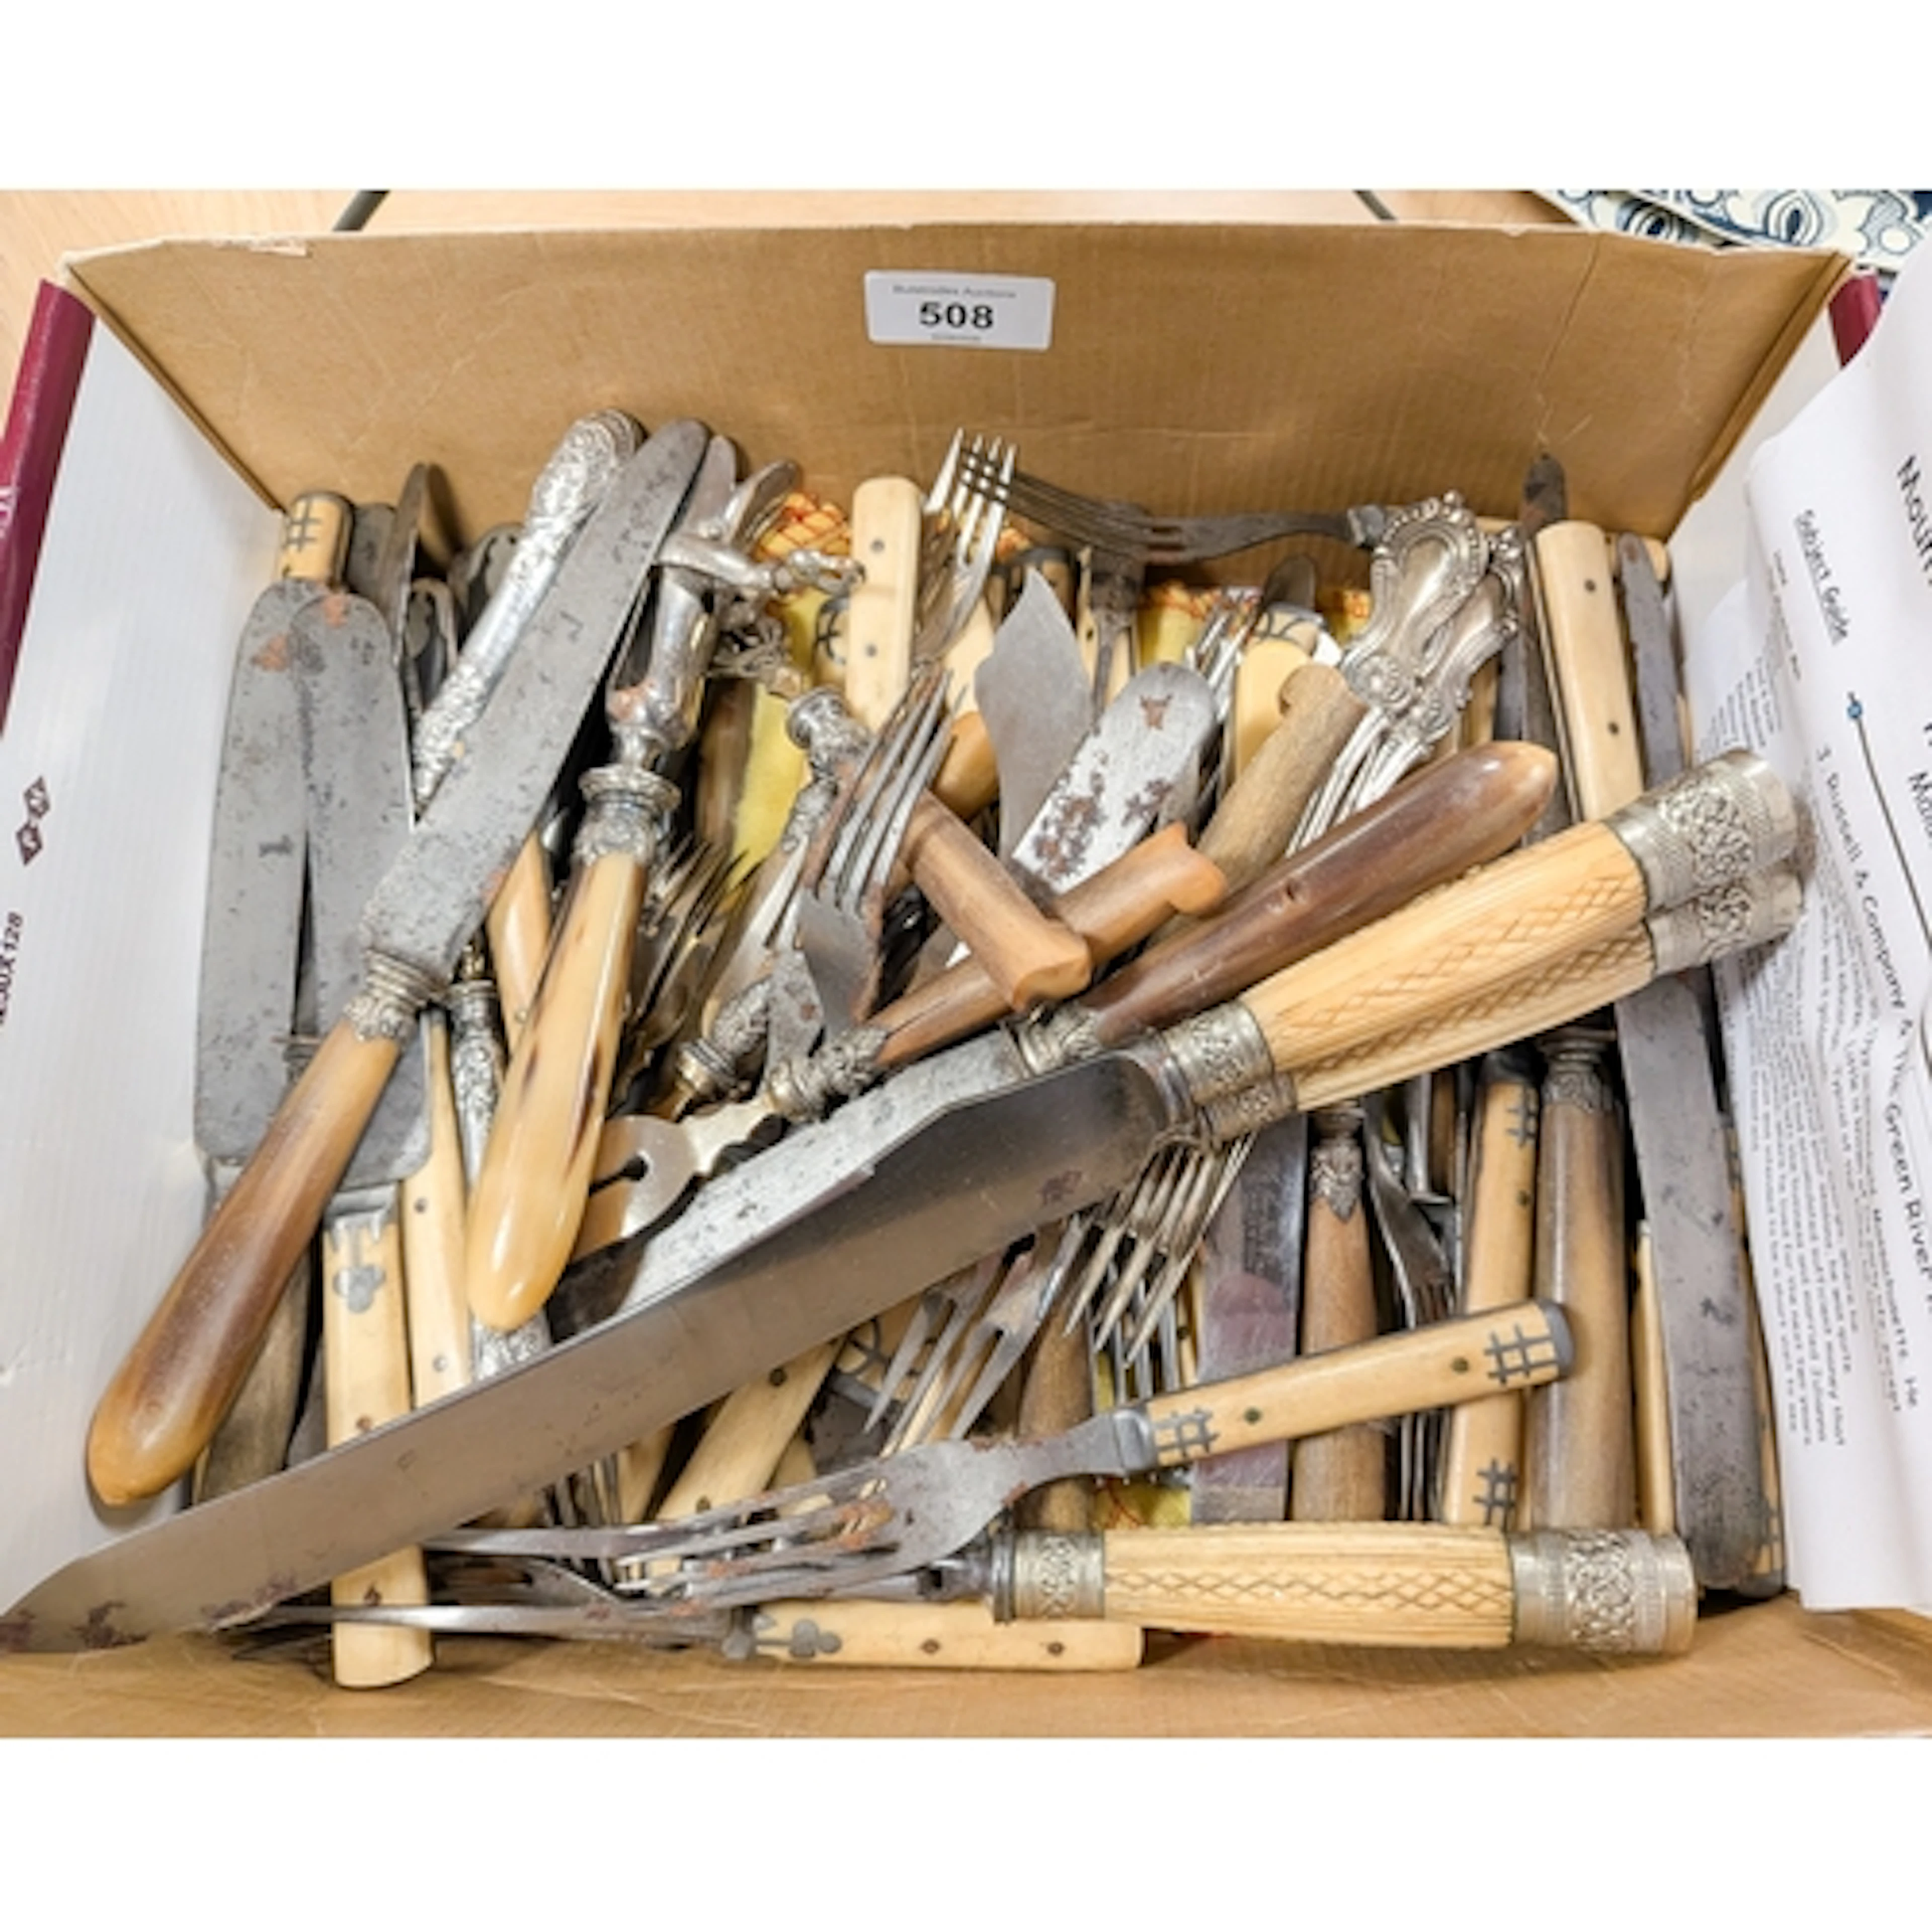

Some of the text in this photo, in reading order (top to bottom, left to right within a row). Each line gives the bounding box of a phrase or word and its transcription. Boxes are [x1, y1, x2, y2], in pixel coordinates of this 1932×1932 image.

[920, 302, 993, 329] 508
[1862, 895, 1906, 1009] Company
[1884, 1102, 1913, 1193] Green
[1904, 1198, 1932, 1281] River
